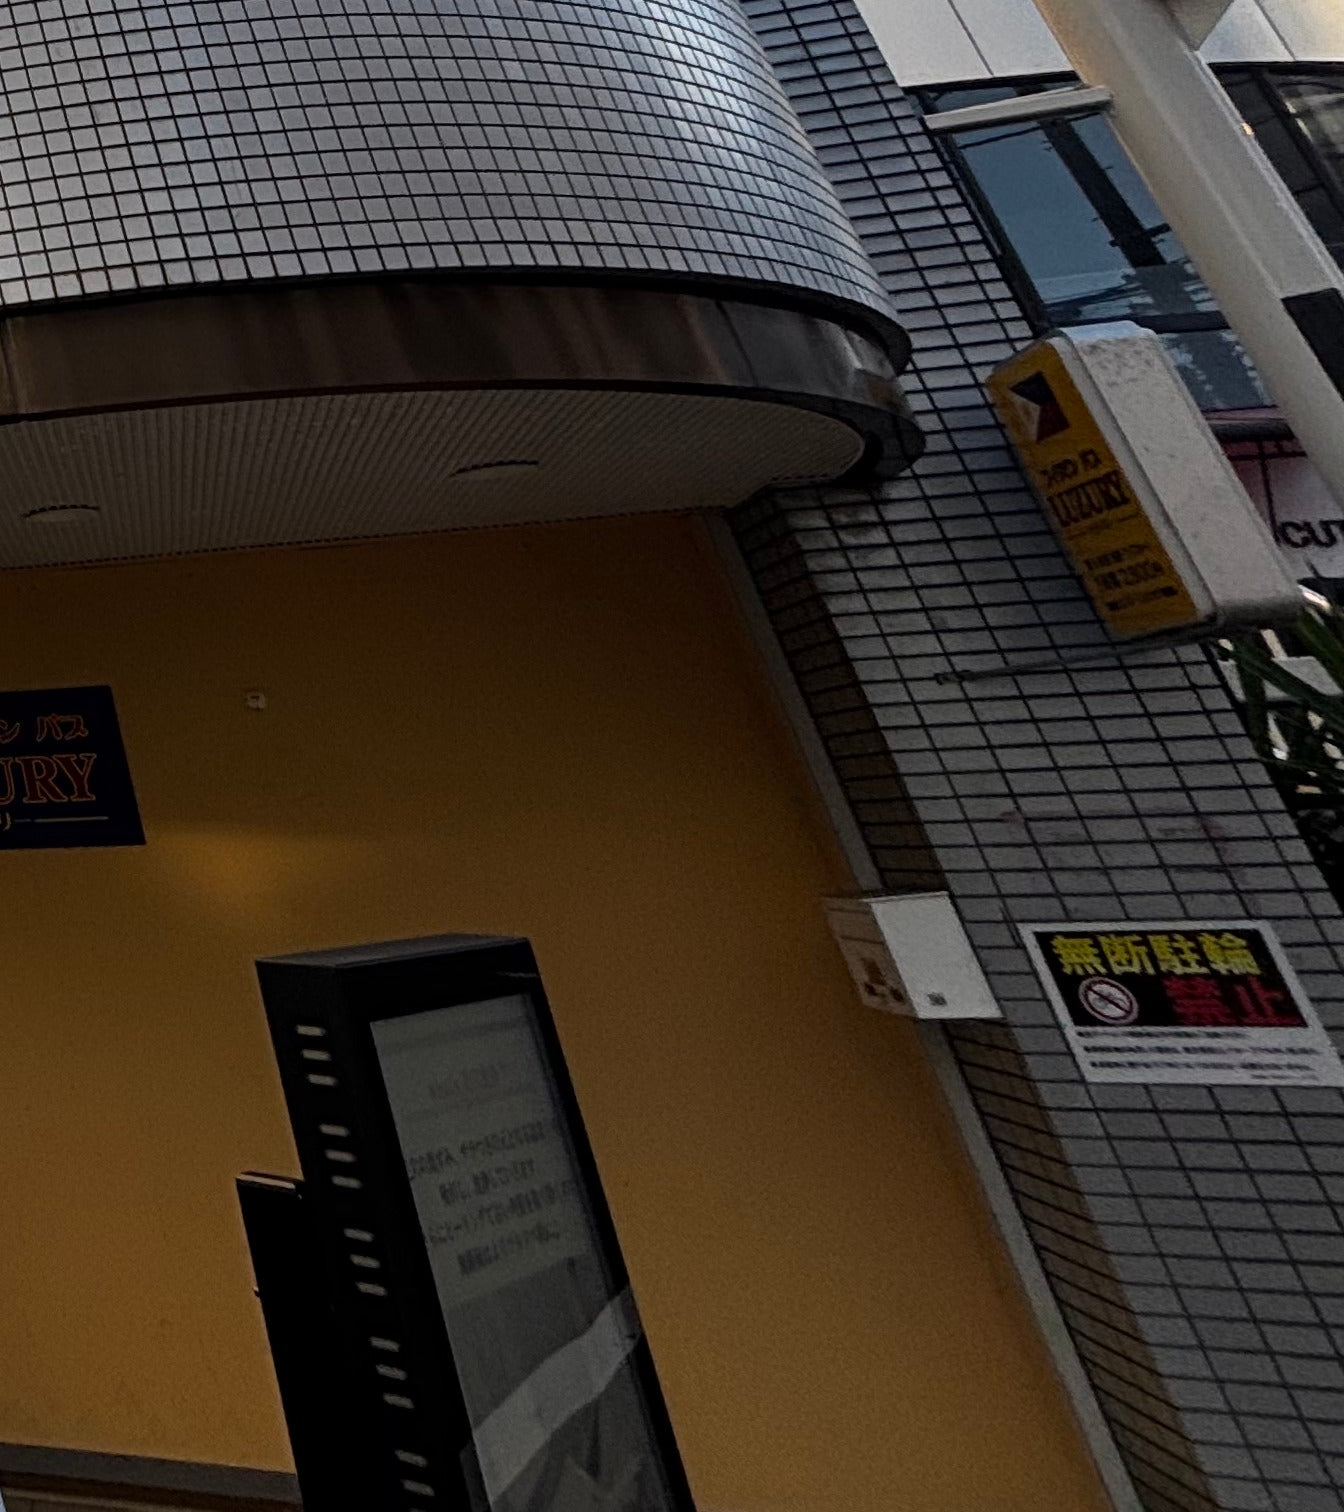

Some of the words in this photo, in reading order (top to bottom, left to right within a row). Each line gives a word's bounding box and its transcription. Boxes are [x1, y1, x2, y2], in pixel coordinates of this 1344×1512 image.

[1050, 932, 1262, 976] 無断駐輪
[1161, 975, 1308, 1027] 禁止
